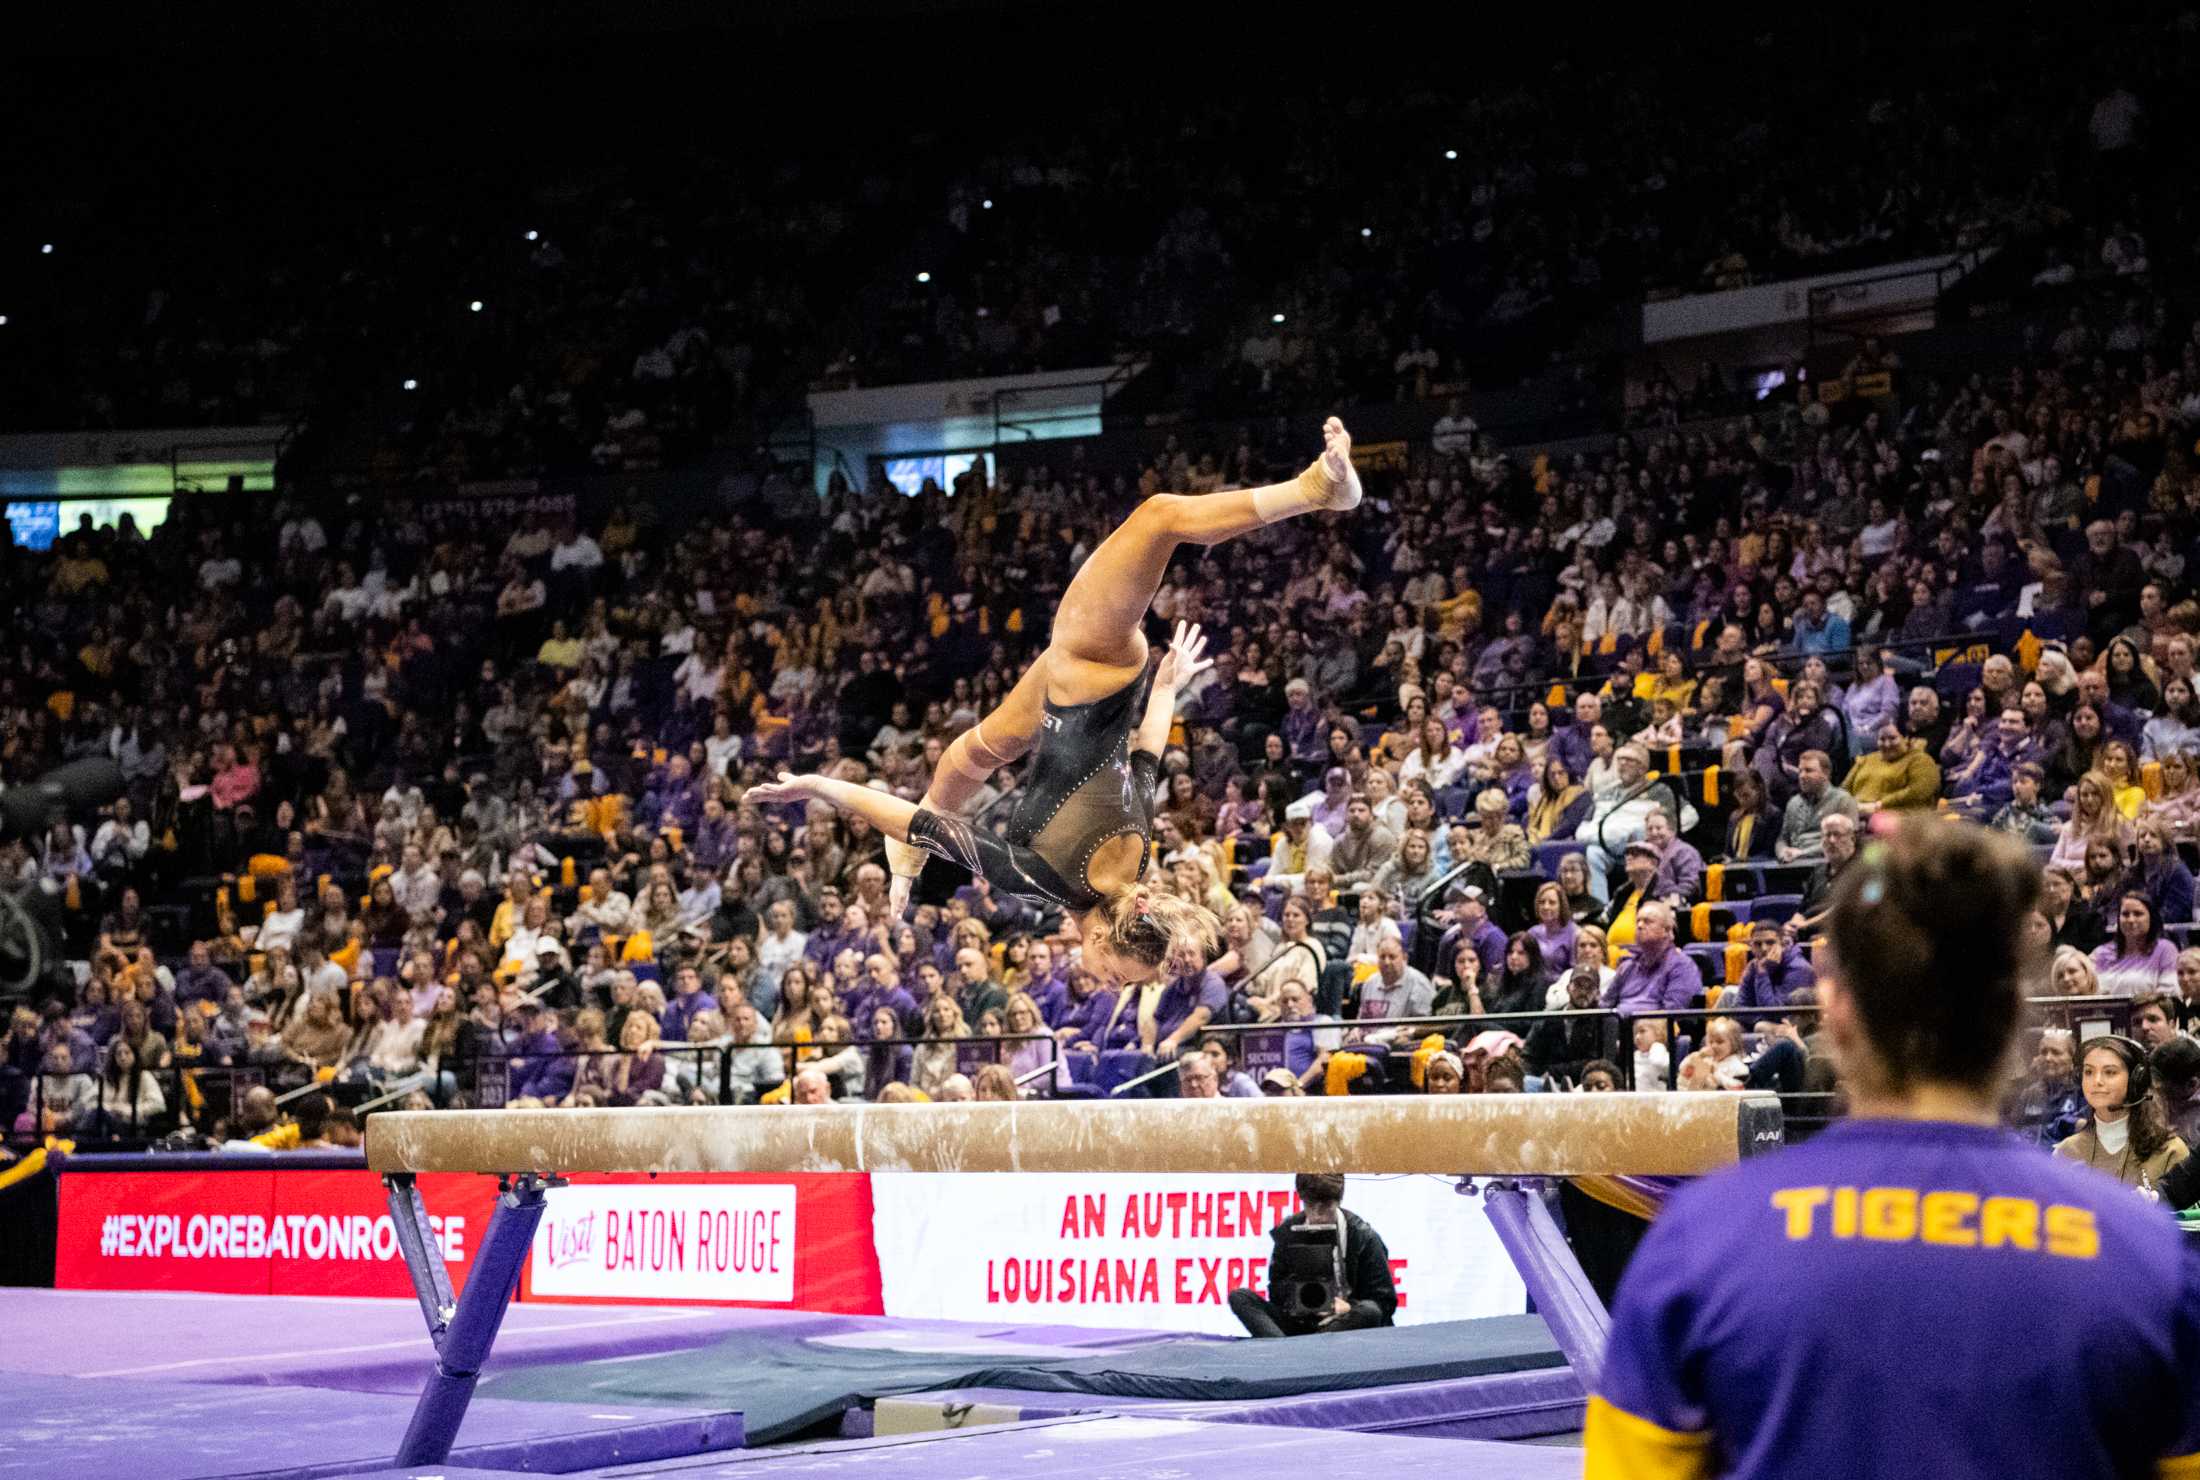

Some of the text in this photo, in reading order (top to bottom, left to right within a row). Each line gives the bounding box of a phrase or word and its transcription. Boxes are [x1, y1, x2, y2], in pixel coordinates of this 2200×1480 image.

[1247, 1052, 1281, 1065] SECTION
[100, 1214, 465, 1262] #EXPLOREBATONROE
[1060, 1193, 1106, 1239] AN
[1771, 1186, 2101, 1260] TIGERS
[546, 1210, 782, 1274] Visit BATON ROUGE
[987, 1256, 1408, 1308] LOUISIANA EXPEE
